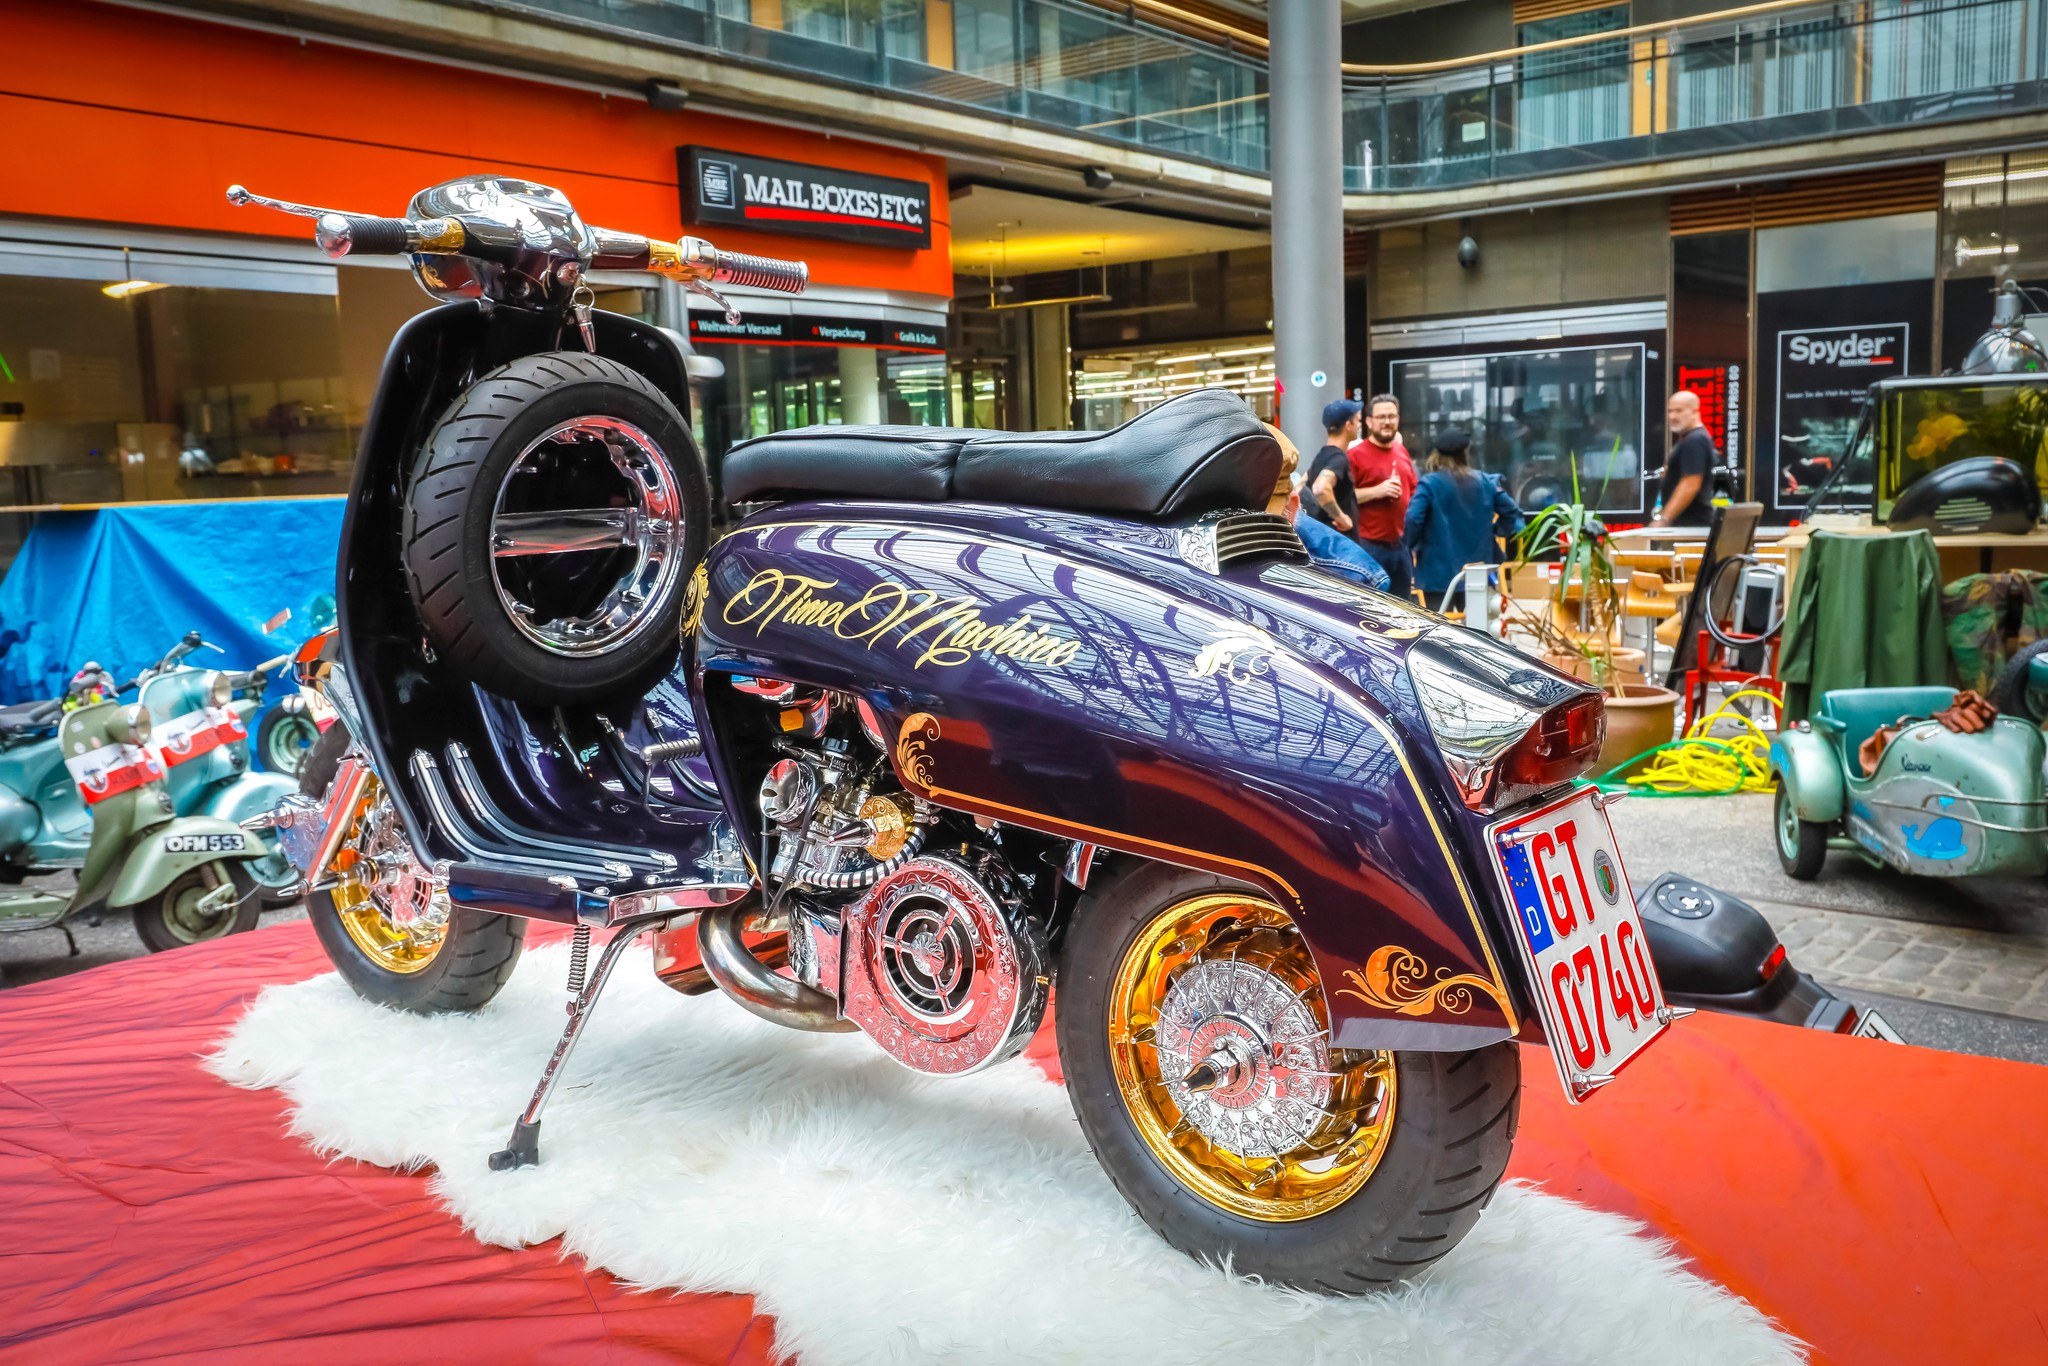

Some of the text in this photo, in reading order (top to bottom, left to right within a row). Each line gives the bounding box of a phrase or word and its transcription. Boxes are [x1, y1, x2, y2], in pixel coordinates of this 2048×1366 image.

[743, 173, 809, 208] MAIL
[810, 183, 878, 219] BOXES
[746, 322, 782, 336] Versand
[819, 326, 866, 340] Verpackung
[921, 333, 937, 345] Druck
[722, 567, 1083, 670] Time Machine
[1531, 818, 1595, 939] GT
[1525, 904, 1543, 937] D
[1550, 918, 1655, 1071] 0740
